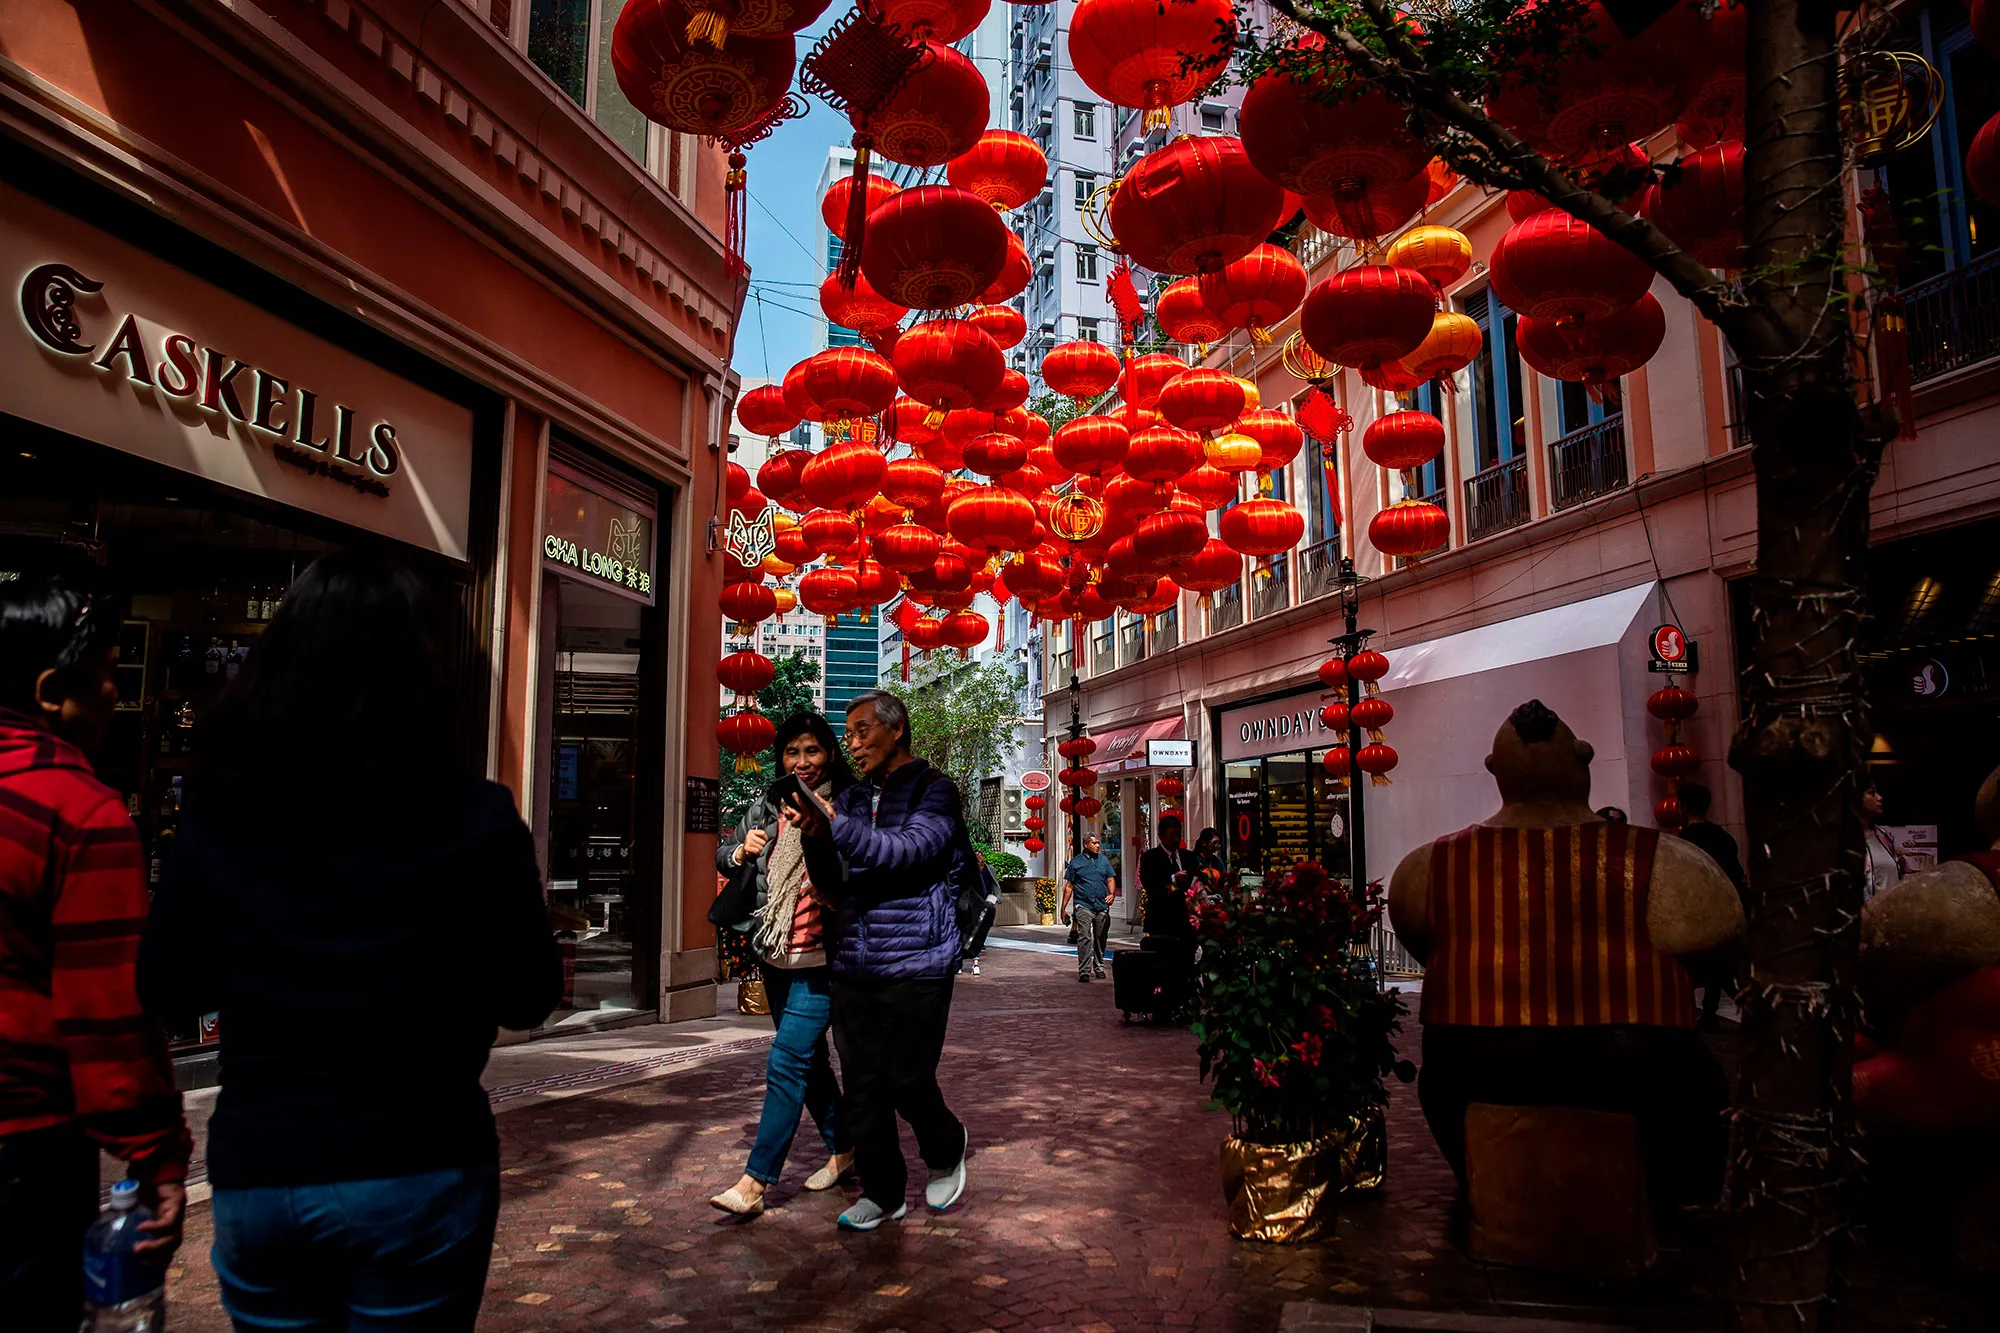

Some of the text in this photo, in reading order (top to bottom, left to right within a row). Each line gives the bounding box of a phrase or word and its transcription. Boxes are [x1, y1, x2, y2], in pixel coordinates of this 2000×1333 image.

[20, 262, 399, 477] CASKELLS
[545, 535, 623, 582] CHA LONG
[1240, 705, 1328, 743] OWNDAYS
